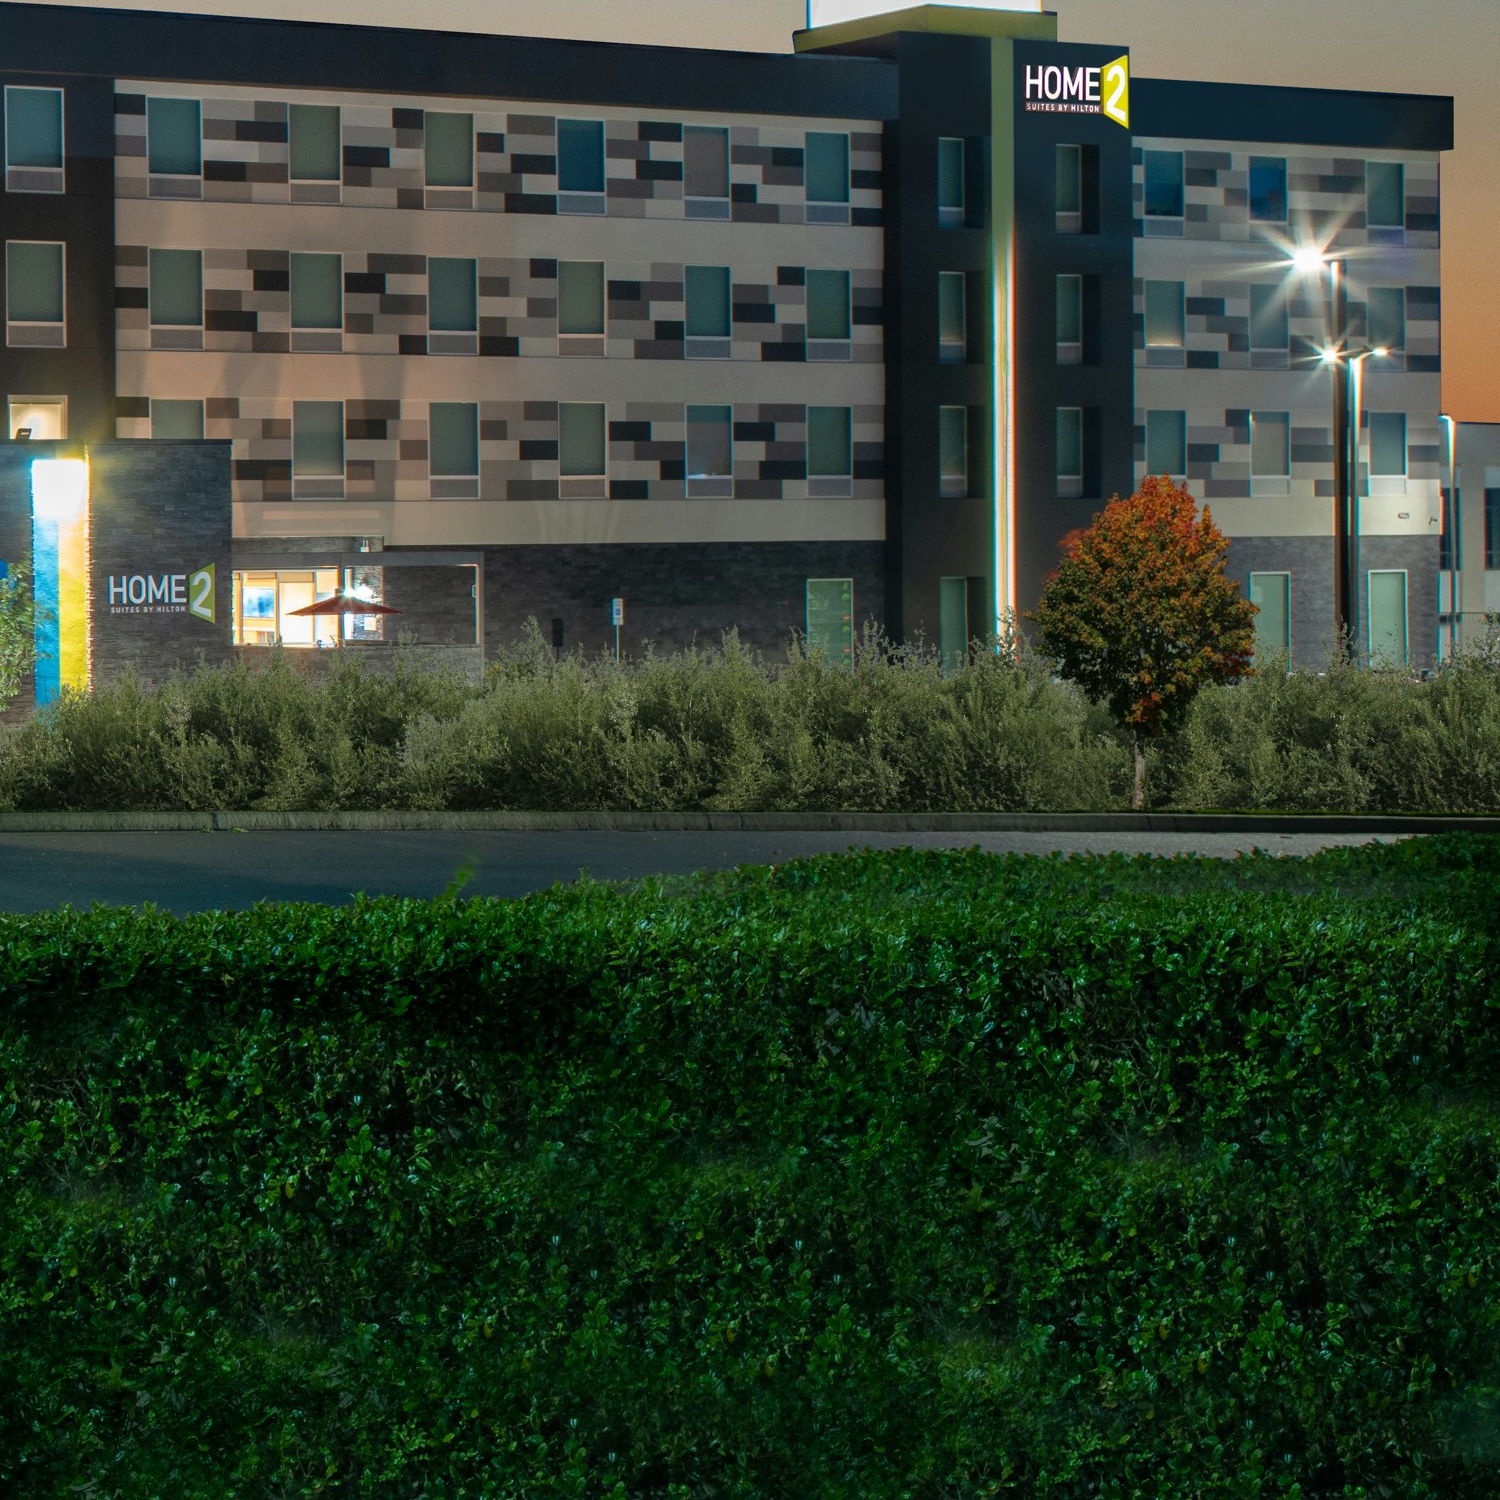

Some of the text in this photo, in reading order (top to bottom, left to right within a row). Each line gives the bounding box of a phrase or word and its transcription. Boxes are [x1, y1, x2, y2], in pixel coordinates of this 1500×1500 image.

[1026, 102, 1100, 113] SUITES BY HILTON
[110, 606, 140, 614] SUITES
[156, 605, 186, 613] HILTON
